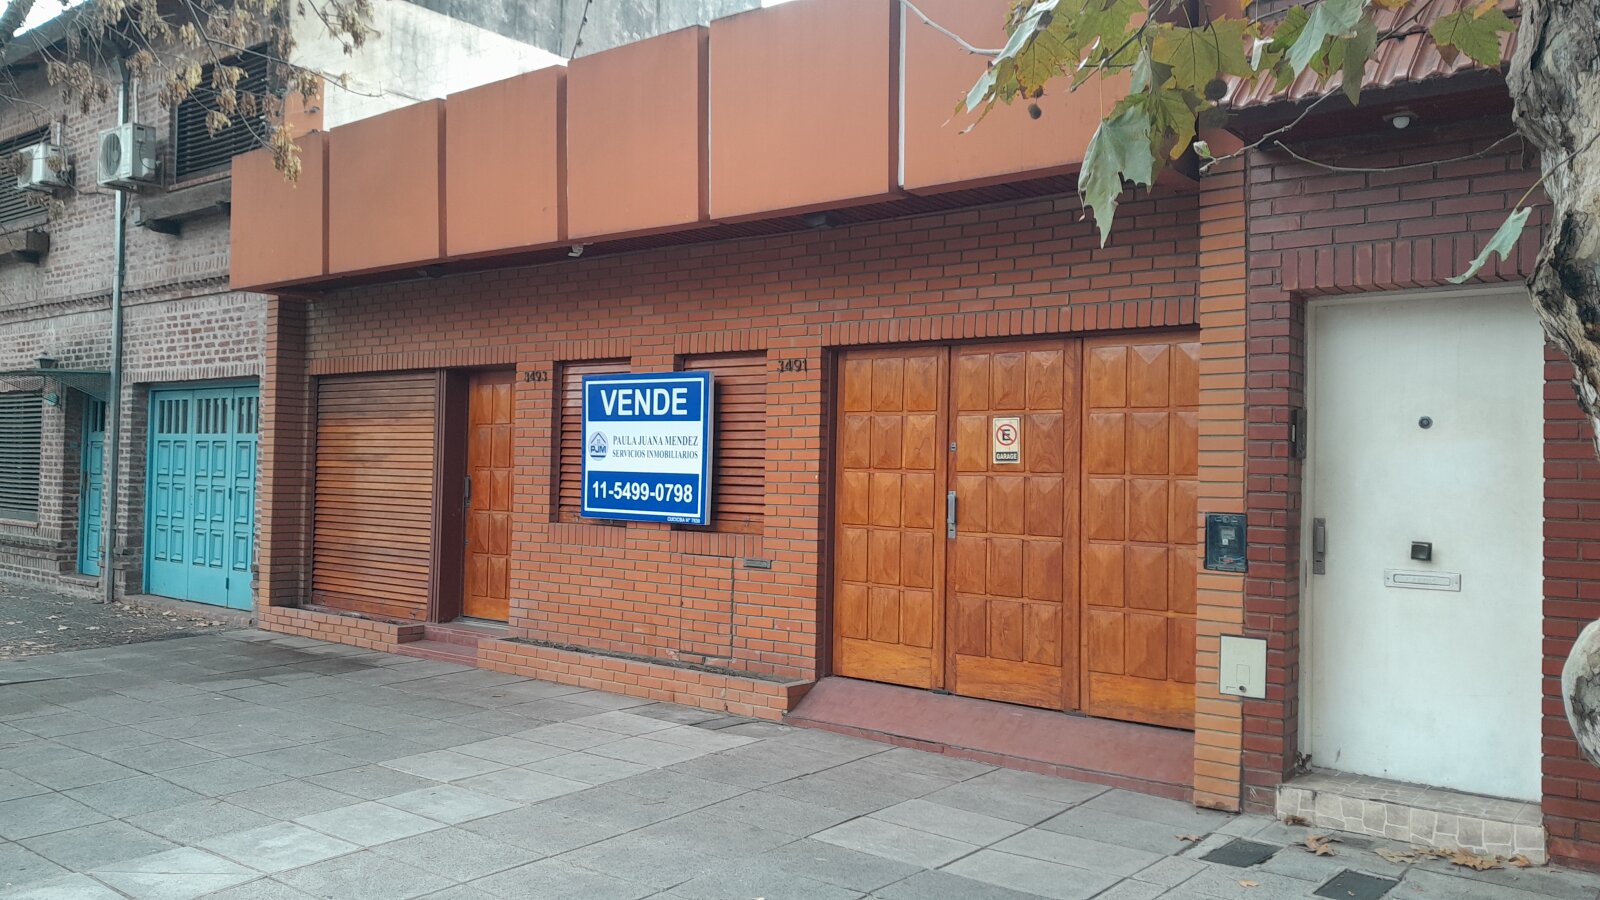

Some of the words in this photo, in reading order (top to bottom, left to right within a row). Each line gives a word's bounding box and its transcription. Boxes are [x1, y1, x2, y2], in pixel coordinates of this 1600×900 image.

[777, 358, 807, 372] 3491
[600, 387, 688, 416] VENDE
[612, 435, 637, 446] PAULA
[638, 435, 663, 446] JUANA
[665, 436, 699, 447] MENDEZ
[1002, 429, 1011, 441] E
[590, 445, 606, 454] PJM
[612, 449, 645, 459] SERVICIOS
[647, 450, 699, 459] INMOBILIARIOS
[592, 480, 693, 503] 11-5499-0798
